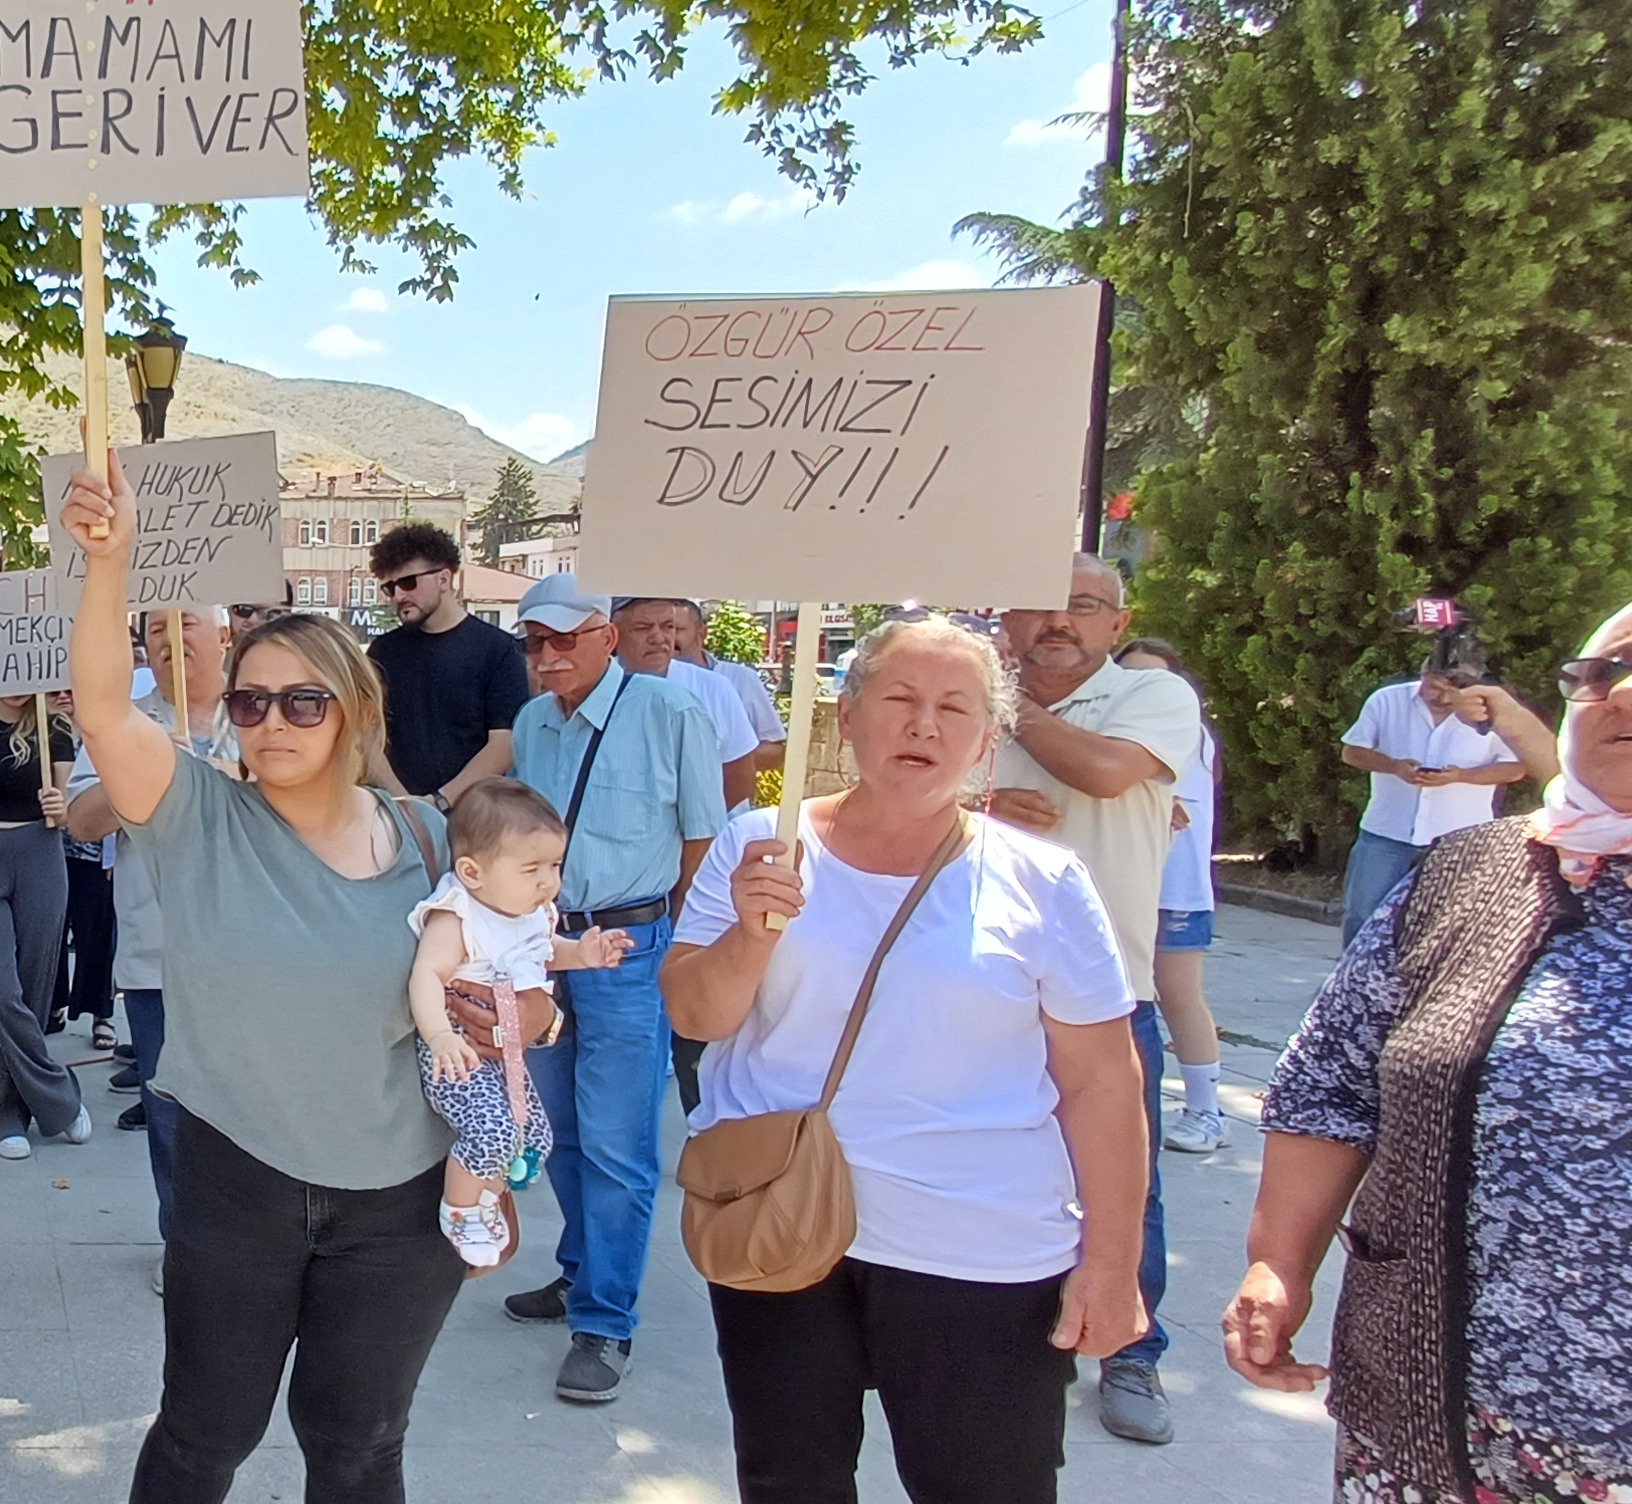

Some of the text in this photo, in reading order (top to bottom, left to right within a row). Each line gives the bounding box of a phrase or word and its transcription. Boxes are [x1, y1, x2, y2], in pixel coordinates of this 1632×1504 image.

[644, 299, 986, 361] ÖZGÜR ÖZEL
[643, 369, 936, 437] SESİMİZİ
[136, 462, 233, 502] HUKUK
[656, 444, 950, 522] DUY!!!
[210, 496, 280, 543] DEDİK
